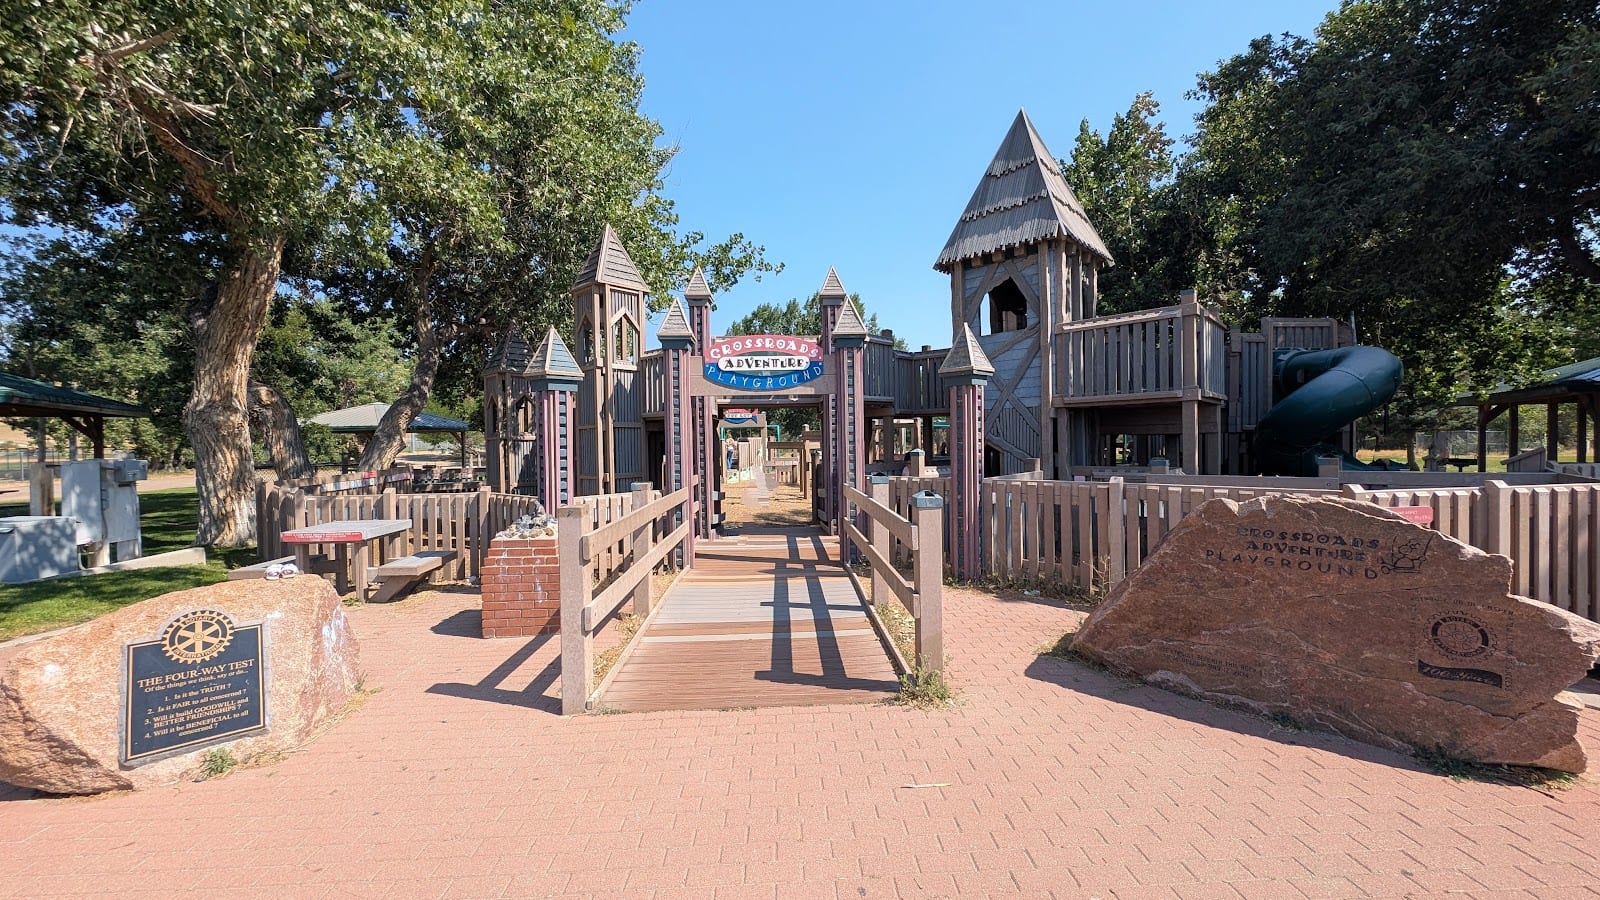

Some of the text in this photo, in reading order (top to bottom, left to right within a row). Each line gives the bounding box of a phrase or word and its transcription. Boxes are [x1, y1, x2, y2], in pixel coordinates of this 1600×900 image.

[710, 338, 819, 359] CROSSROADS
[724, 358, 805, 369] ADVENTURE
[707, 366, 821, 388] PLAYGROUND
[1236, 527, 1381, 549] CROSSROADS
[1246, 540, 1369, 562] ADVENTURE
[1205, 549, 1378, 580] PLAYGROUND
[185, 616, 211, 624] ROTARY
[137, 658, 254, 688] THE FOUR-WAY TEST
[166, 681, 187, 689] things
[200, 685, 226, 694] TRUTH
[172, 700, 191, 710] FAIR
[209, 690, 242, 701] concerned
[153, 714, 168, 722] Will
[175, 710, 194, 718] build
[194, 701, 236, 714] GOODWILL
[153, 716, 185, 728] BETTER
[186, 706, 237, 721] FRIENDSHIPS
[153, 728, 169, 737] Will
[186, 714, 232, 729] BENEFICIAL
[178, 724, 213, 737] concerned
